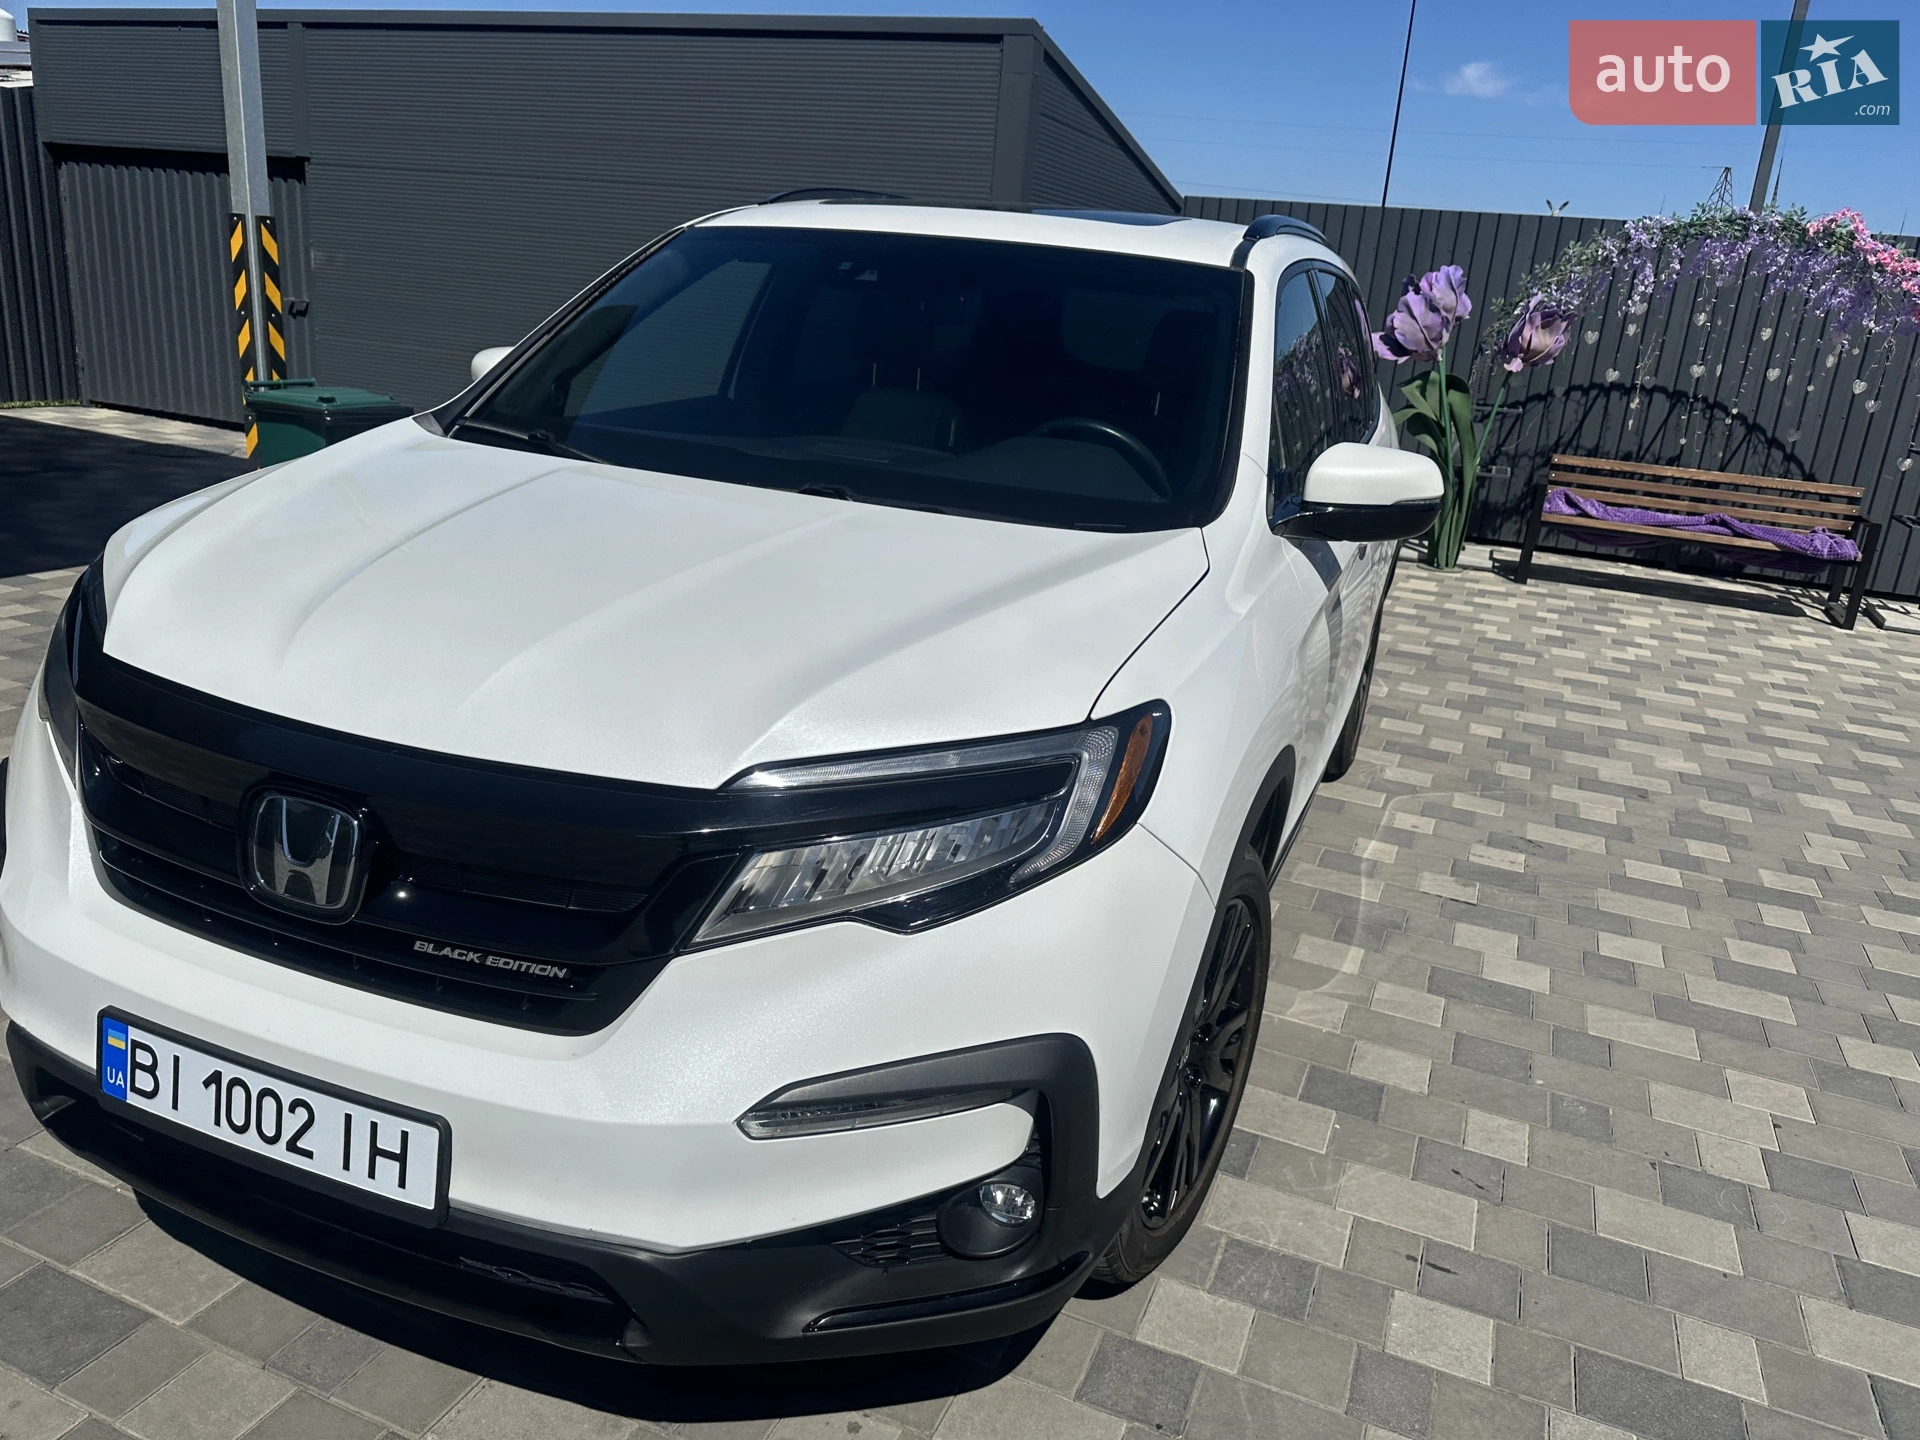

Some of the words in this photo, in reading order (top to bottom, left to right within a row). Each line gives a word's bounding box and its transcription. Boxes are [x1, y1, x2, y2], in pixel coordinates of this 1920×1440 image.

[413, 940, 483, 964] BLACK
[485, 955, 567, 979] EDITION
[107, 1066, 125, 1090] UA
[130, 1038, 180, 1111] BI
[201, 1069, 315, 1160] 1002
[342, 1112, 409, 1190] IH
